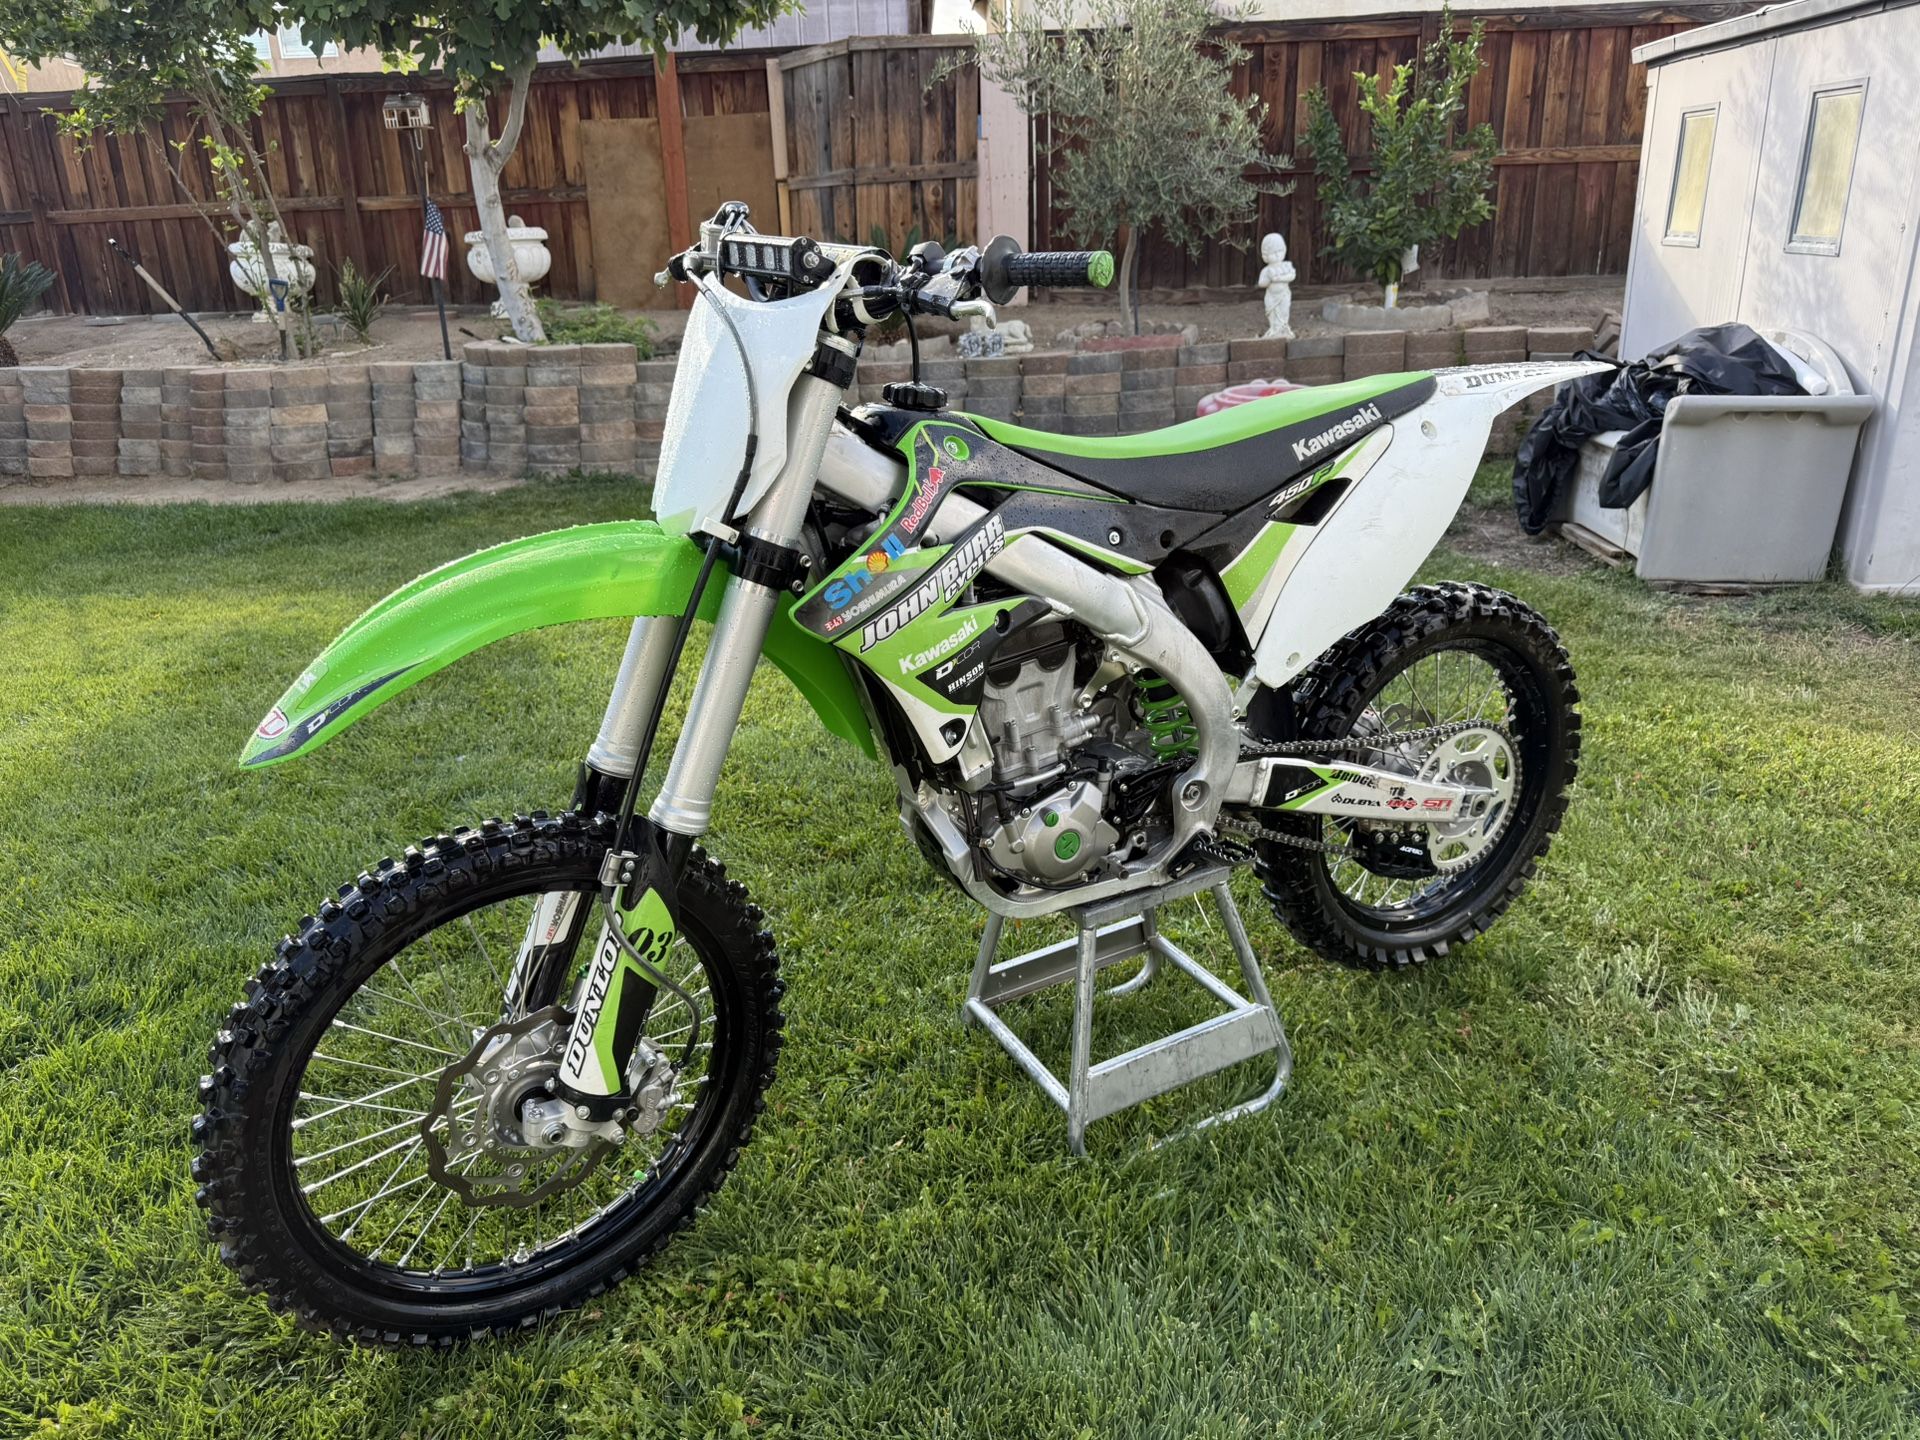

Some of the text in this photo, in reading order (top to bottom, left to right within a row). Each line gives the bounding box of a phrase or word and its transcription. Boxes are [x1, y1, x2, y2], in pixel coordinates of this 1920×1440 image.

[1292, 402, 1382, 461] Kawasaki
[1268, 463, 1335, 508] 450F
[860, 513, 1005, 653] JOHN BURR
[944, 533, 1005, 604] CYCLES
[841, 574, 907, 622] YOSHIMURA
[898, 614, 979, 674] Kawasaki
[947, 661, 985, 693] HINSON
[1342, 799, 1381, 807] DUBYA
